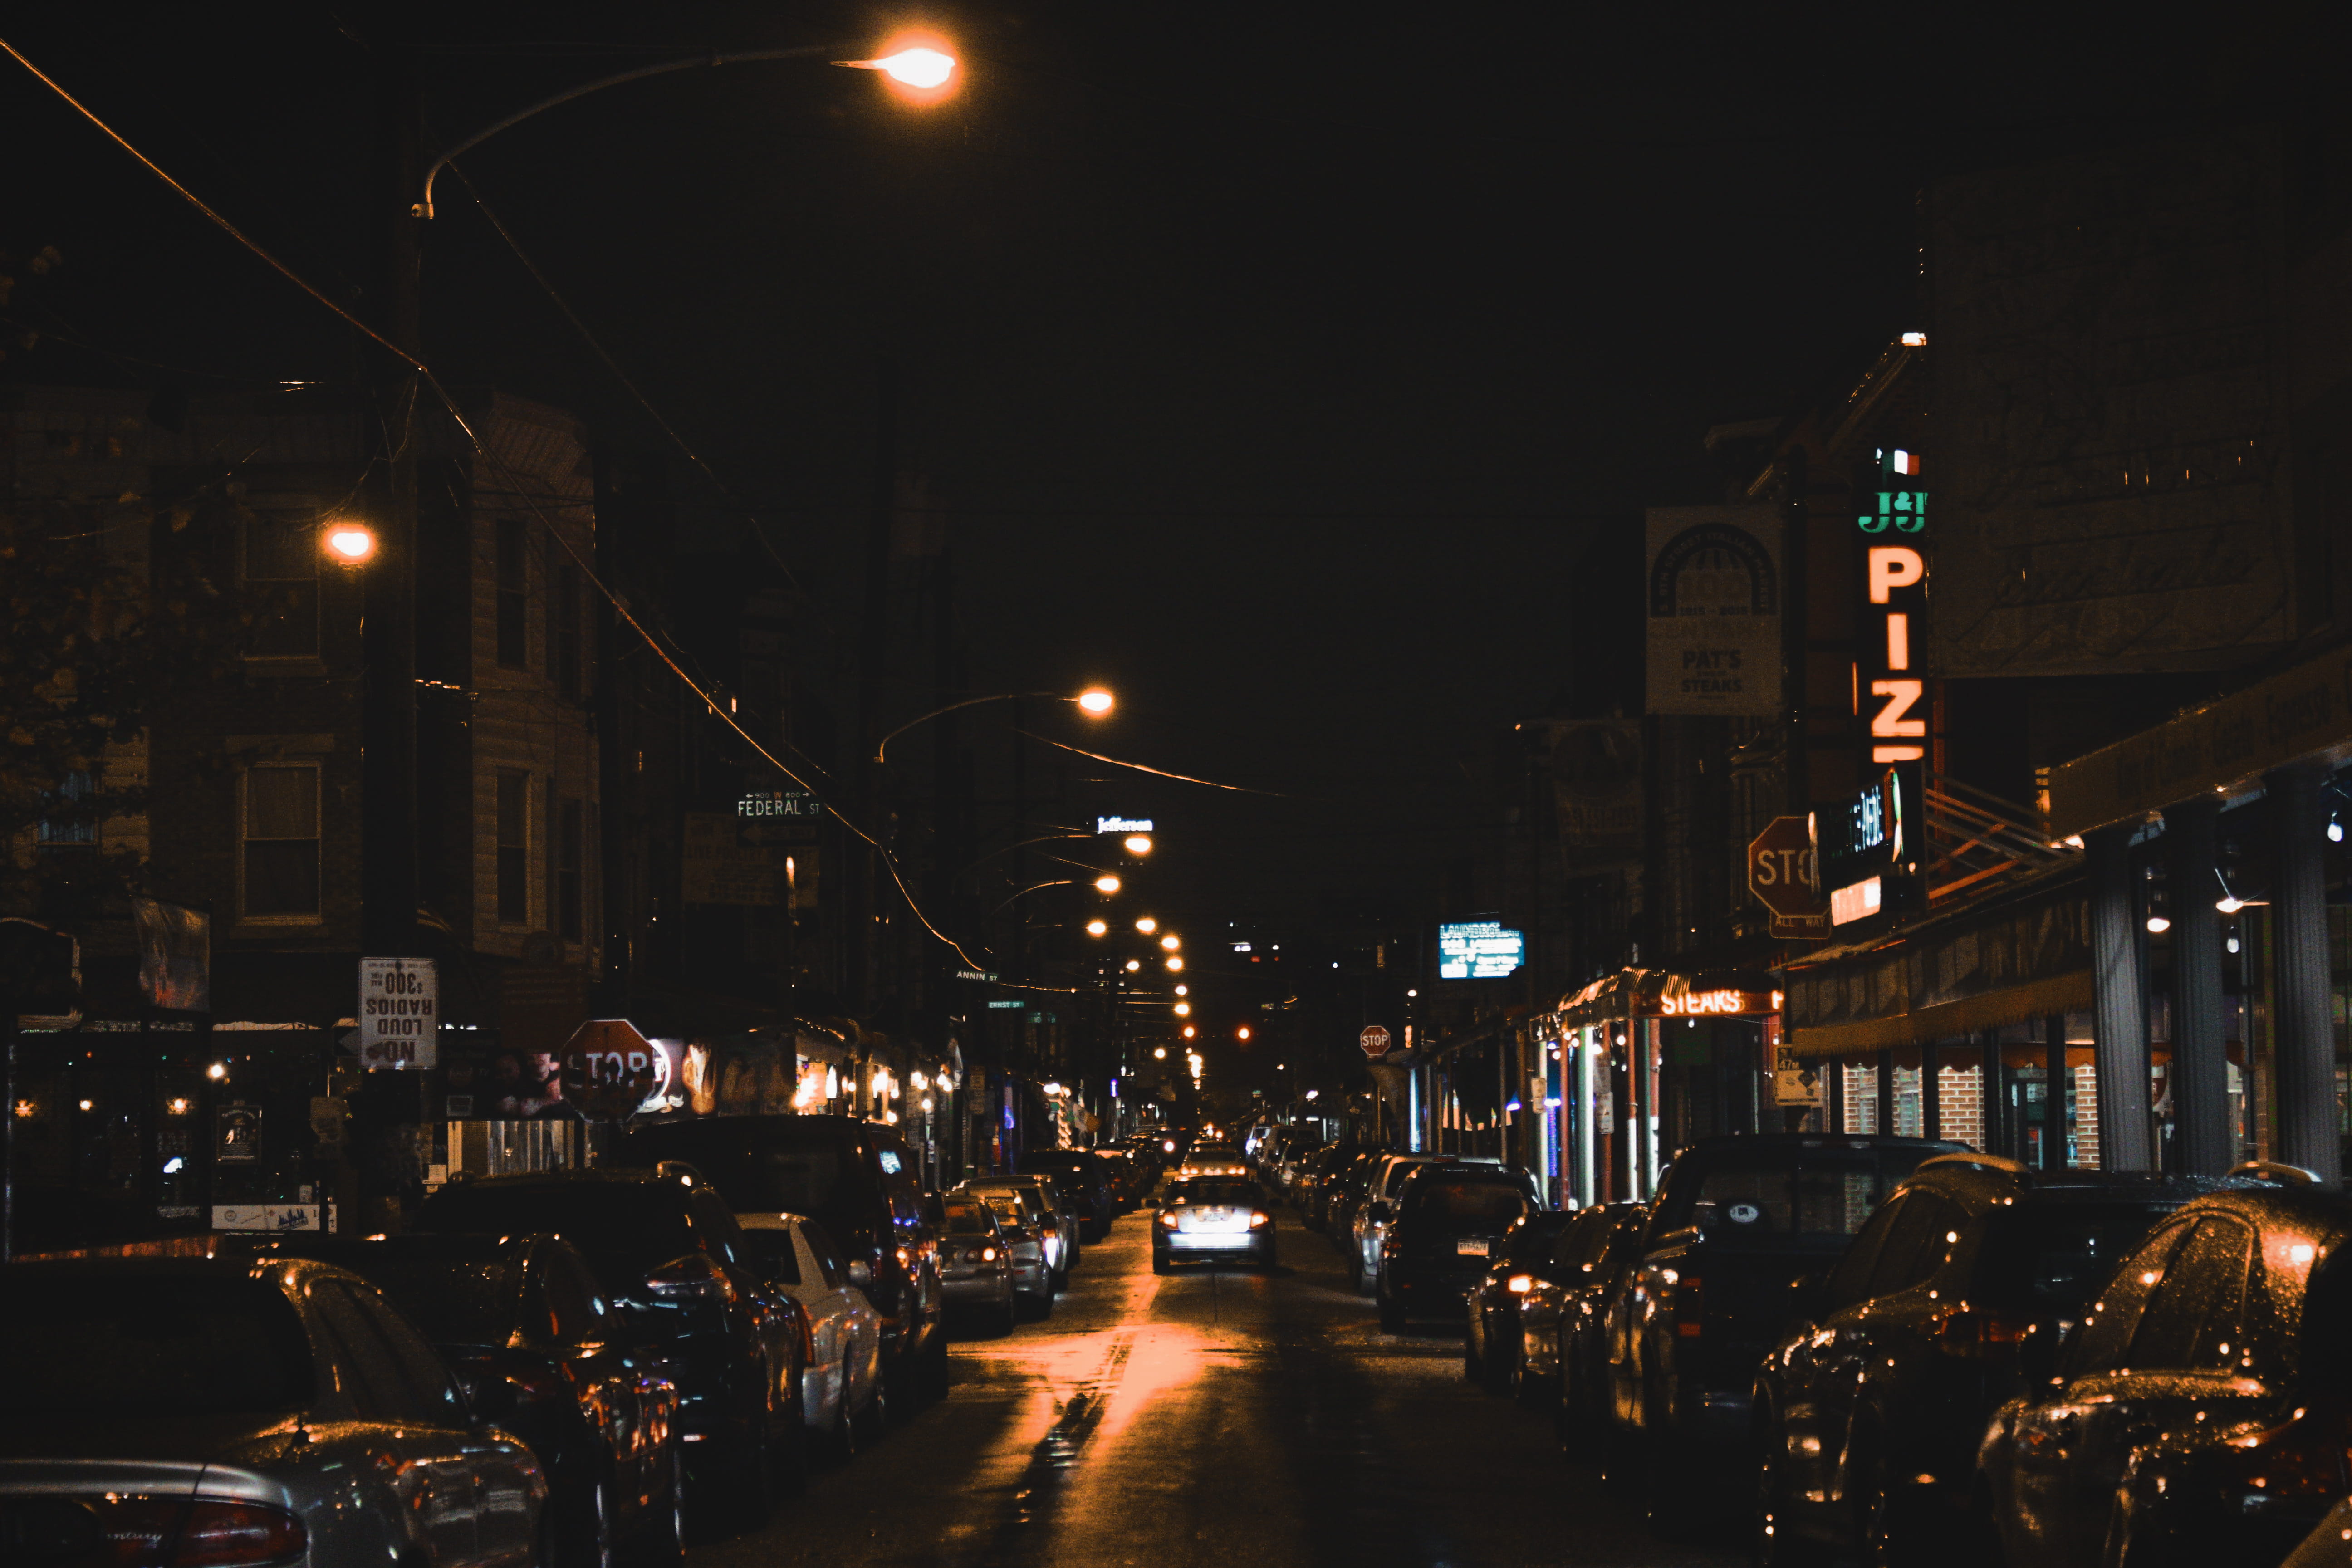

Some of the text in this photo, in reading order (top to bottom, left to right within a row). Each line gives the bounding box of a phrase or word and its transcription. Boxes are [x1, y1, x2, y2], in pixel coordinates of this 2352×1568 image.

[1858, 492, 1928, 533] J&J
[1682, 649, 1742, 670] PAT'S
[1868, 546, 1926, 765] PIZ
[1681, 679, 1743, 693] STEAKS
[738, 800, 819, 817] FEDERAL ST
[1757, 848, 1812, 885] STO
[1775, 916, 1826, 928] ALL WAY
[956, 970, 985, 980] ANNIN
[366, 999, 431, 1015] RADIOS
[1661, 990, 1745, 1014] STEAKS
[377, 1019, 422, 1035] LOUD
[1362, 1034, 1388, 1046] STOP
[385, 1041, 415, 1063] NO
[568, 1051, 648, 1089] STOP
